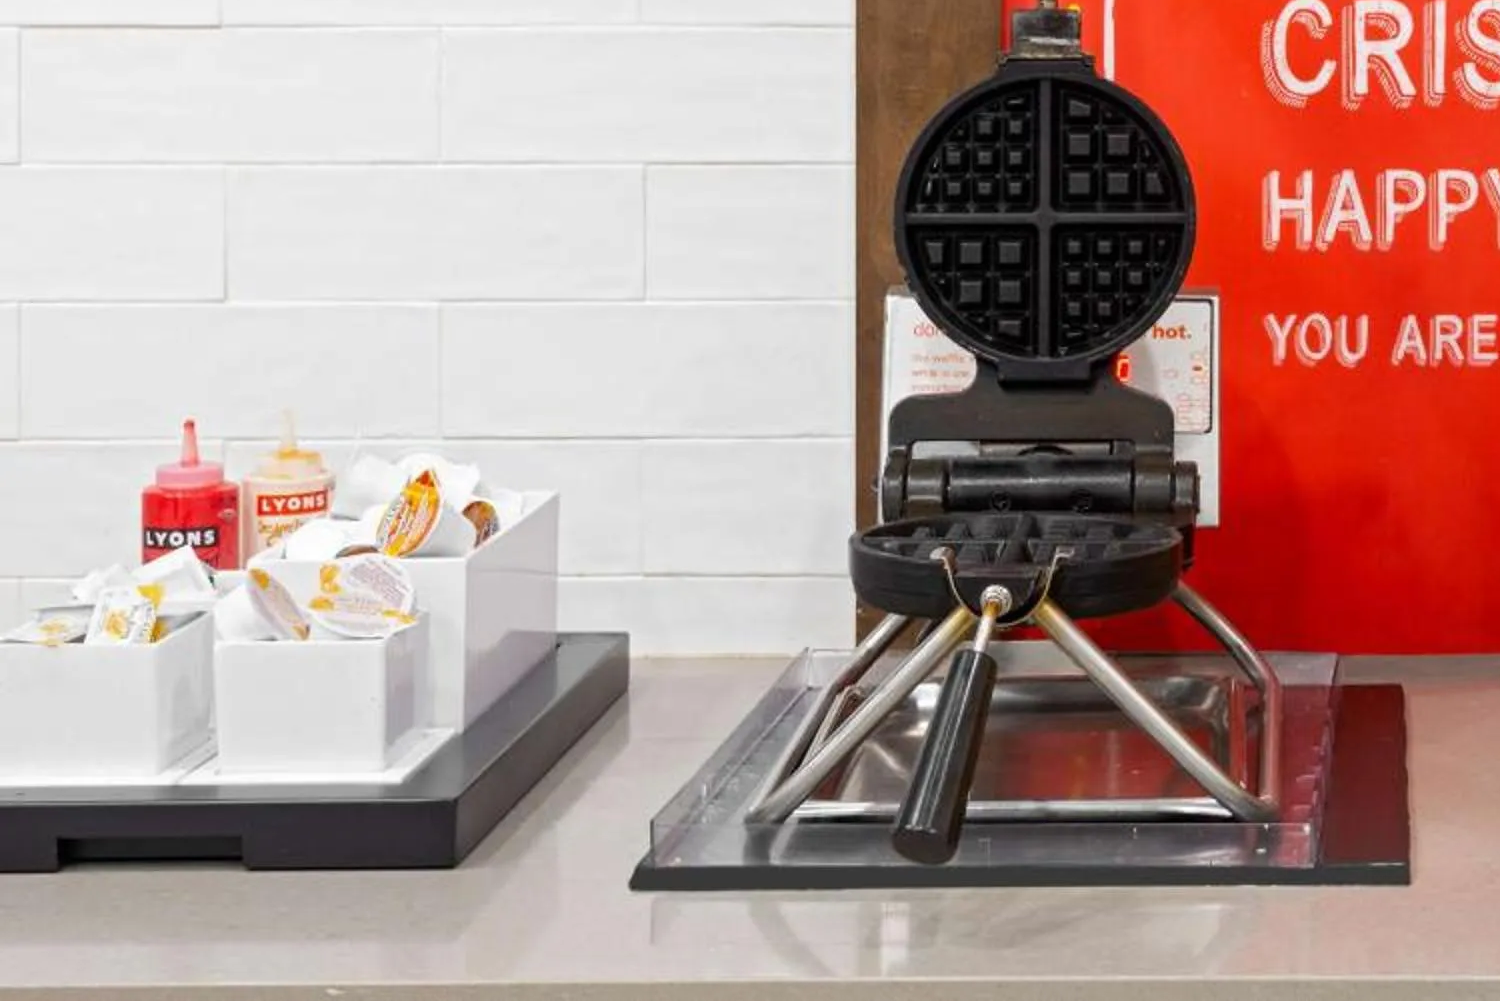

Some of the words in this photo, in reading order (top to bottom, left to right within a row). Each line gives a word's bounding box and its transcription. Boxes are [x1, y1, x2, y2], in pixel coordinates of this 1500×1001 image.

[1152, 324, 1192, 339] hot.
[1264, 313, 1368, 367] YOU
[1392, 314, 1498, 365] ARE
[263, 496, 325, 512] LYONS
[145, 529, 216, 547] LYONS
